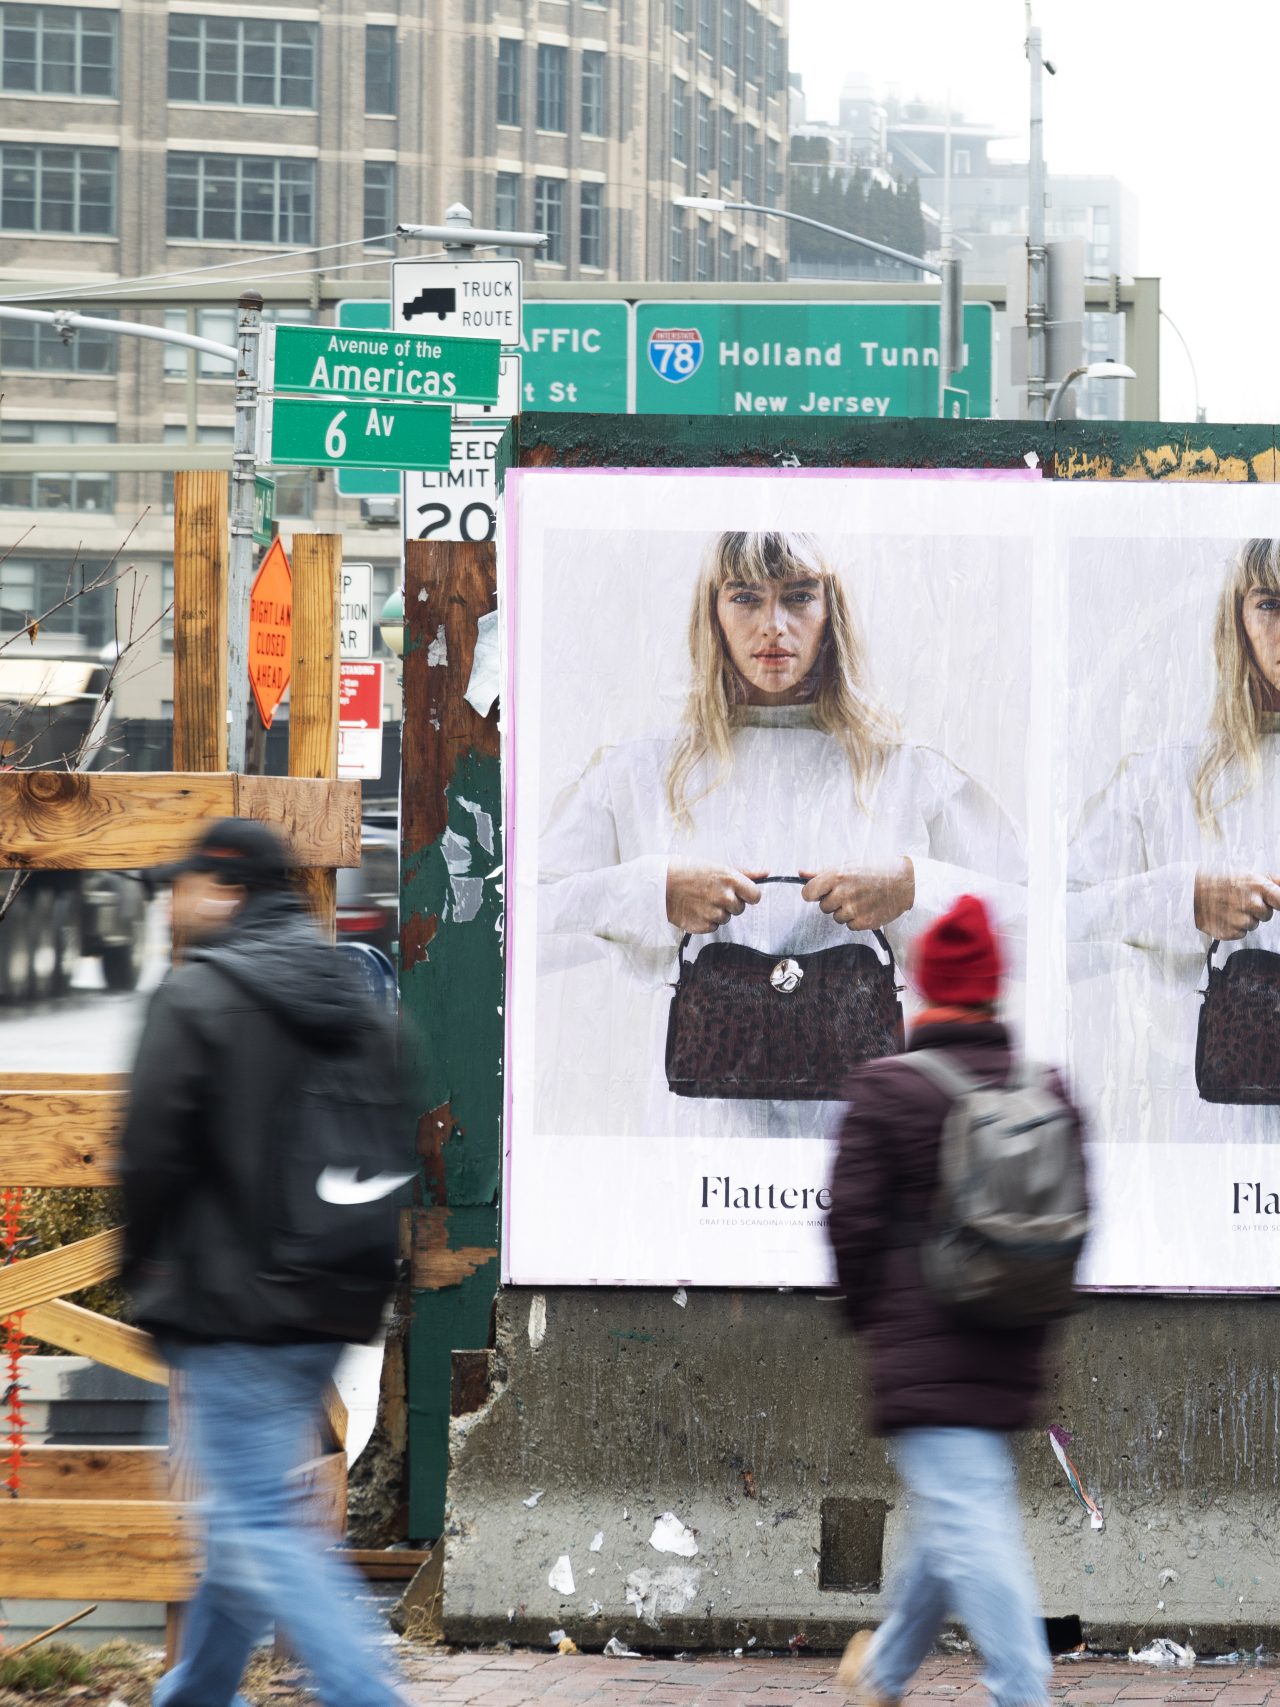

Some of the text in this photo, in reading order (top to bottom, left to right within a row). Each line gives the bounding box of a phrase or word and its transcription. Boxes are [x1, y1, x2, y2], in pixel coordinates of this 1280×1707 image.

[462, 281, 513, 298] TRUCK
[462, 310, 513, 327] ROUTE
[328, 335, 442, 359] Avenue of the
[653, 343, 695, 374] 78
[719, 342, 969, 367] Holland Tunnl
[309, 356, 457, 397] Americas
[549, 381, 578, 402] St
[735, 392, 891, 416] New Jersey
[324, 408, 394, 458] 6 Av
[450, 441, 497, 460] EED
[422, 468, 489, 488] LIMIT
[417, 501, 496, 541] 20
[251, 599, 291, 627] RIGHT LAN
[257, 631, 287, 658] CLOSED
[256, 664, 283, 690] AHEAD
[701, 1176, 833, 1211] Flattere
[700, 1218, 738, 1227] CRAFTED
[740, 1218, 804, 1227] SCANDINAVIAN
[1231, 1224, 1269, 1232] CRAFTED
